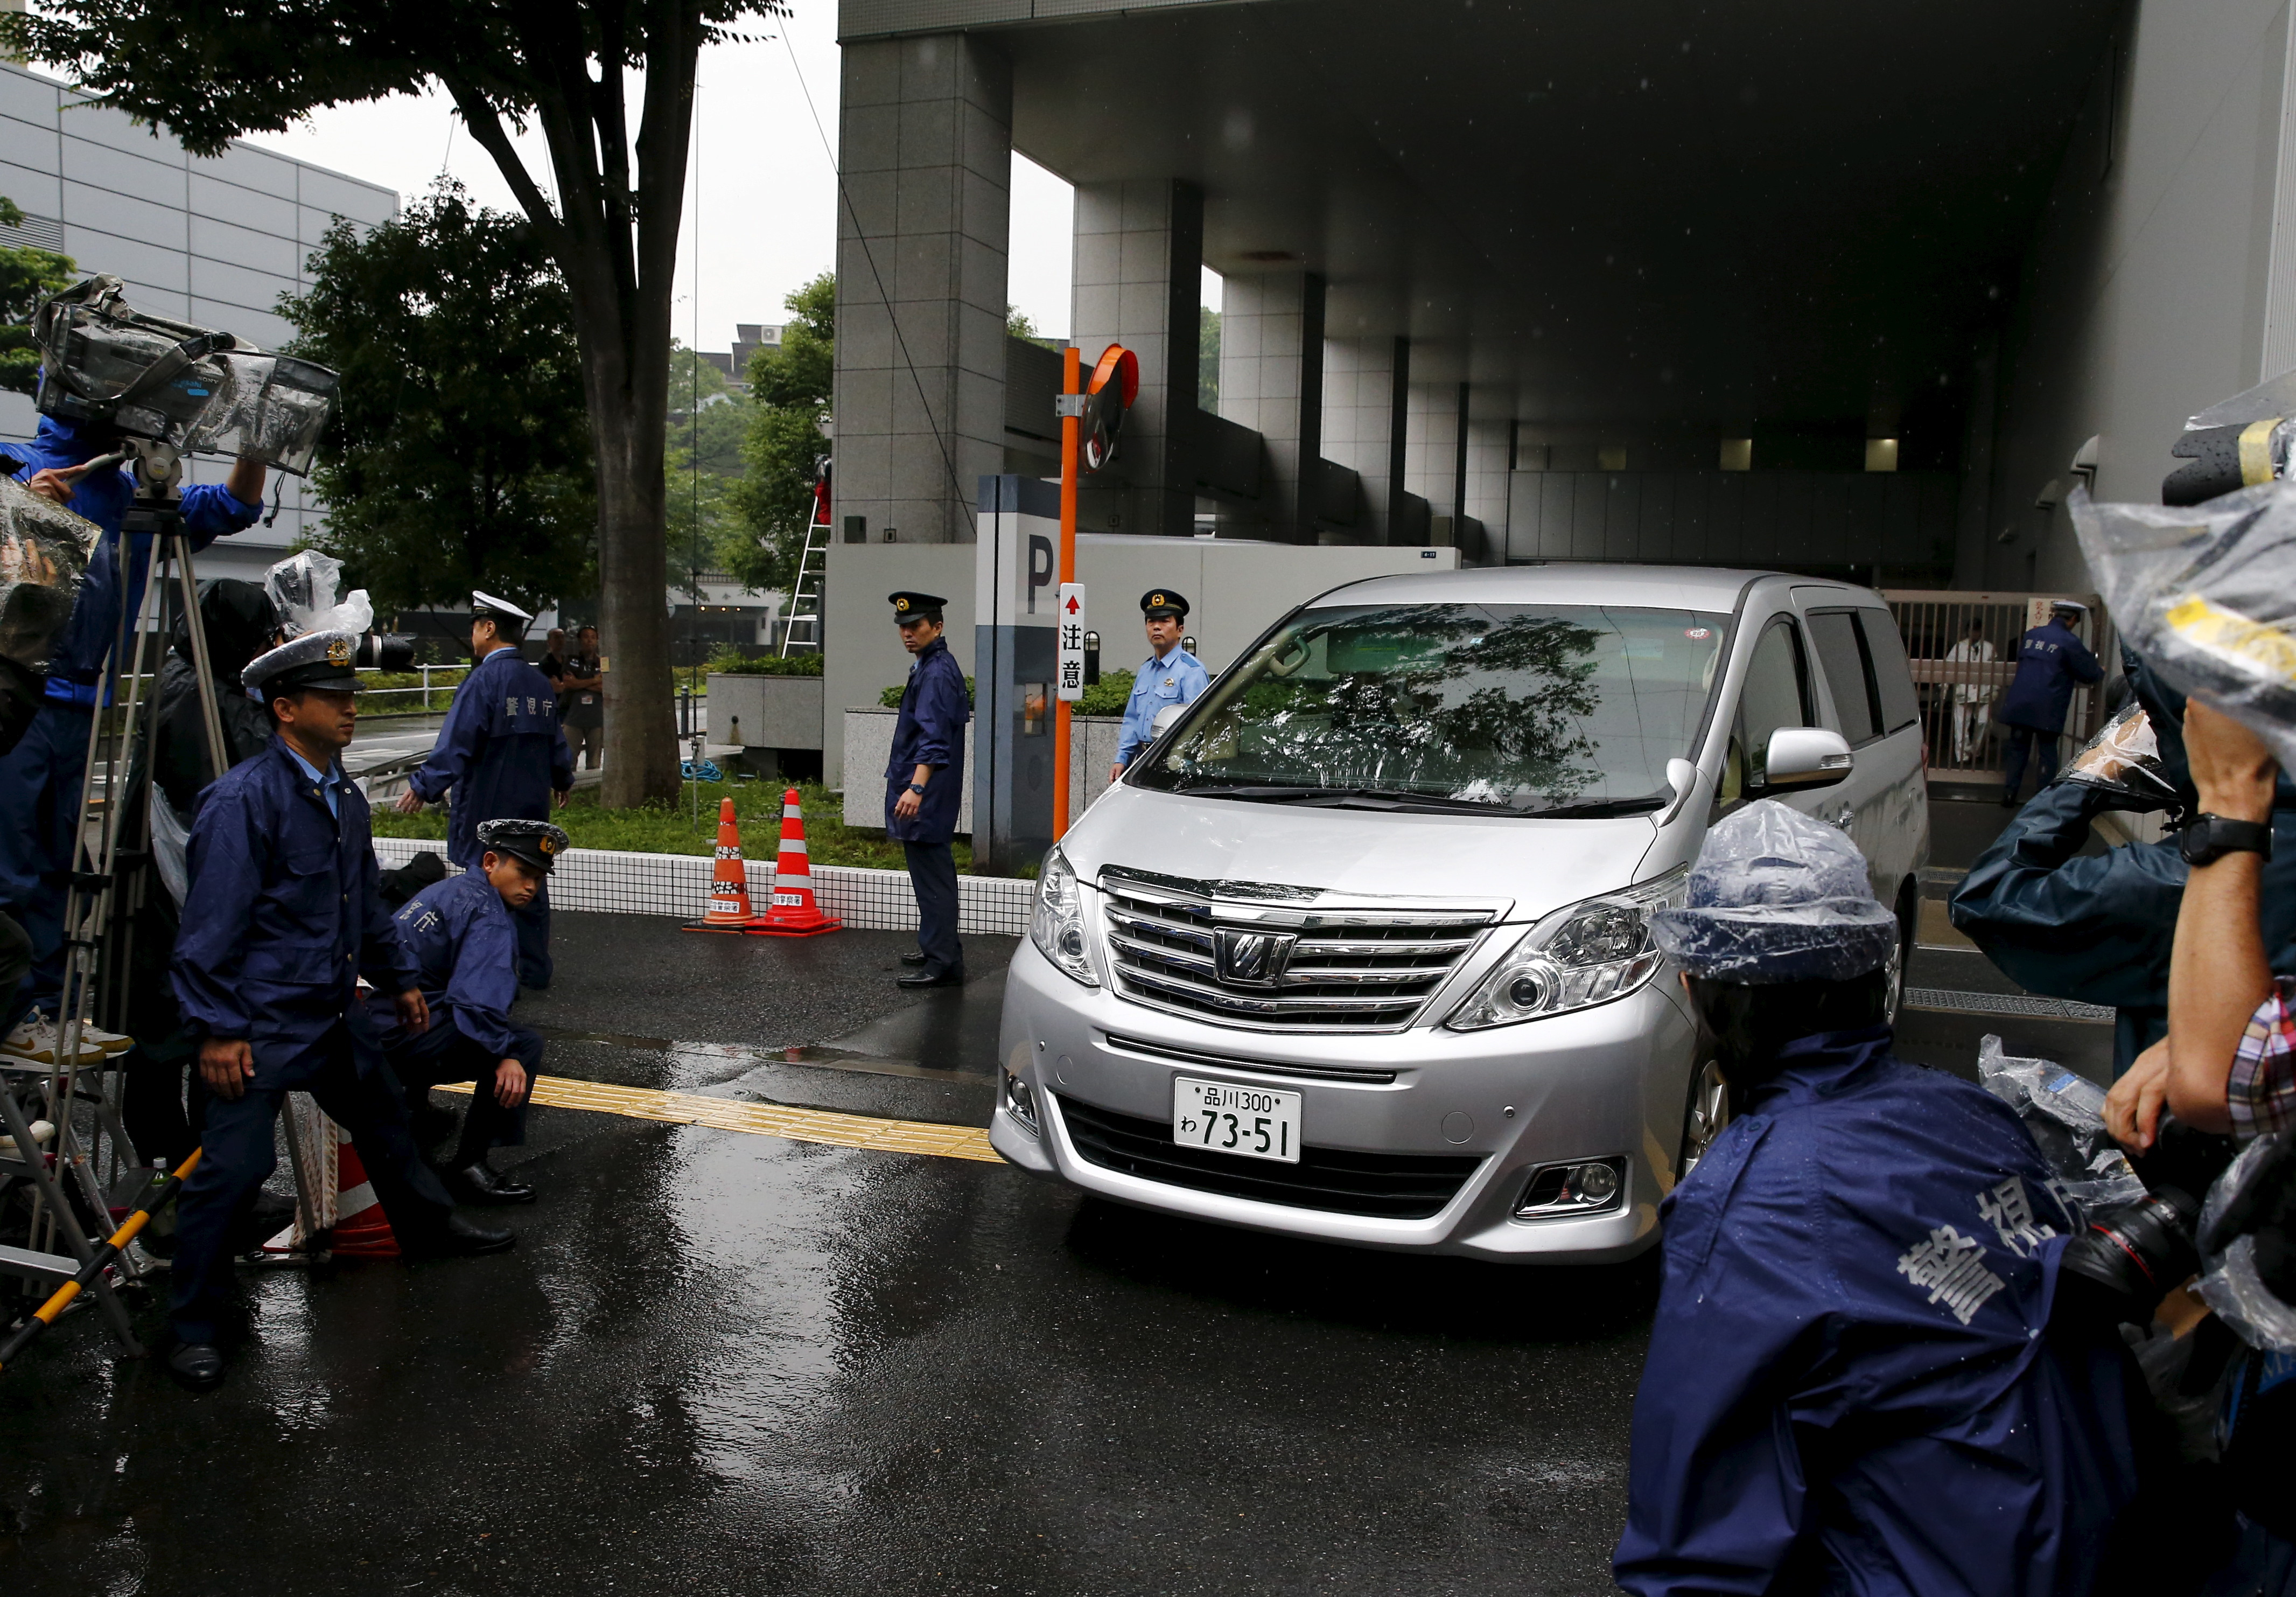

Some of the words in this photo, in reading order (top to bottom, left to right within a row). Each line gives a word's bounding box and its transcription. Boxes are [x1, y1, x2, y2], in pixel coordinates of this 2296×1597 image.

[197, 376, 219, 384] SONY
[1027, 534, 1054, 614] P
[1062, 624, 1082, 689] 注意
[506, 696, 552, 716] 警視庁
[1181, 1115, 1197, 1132] わ
[1201, 1110, 1287, 1156] 73-51
